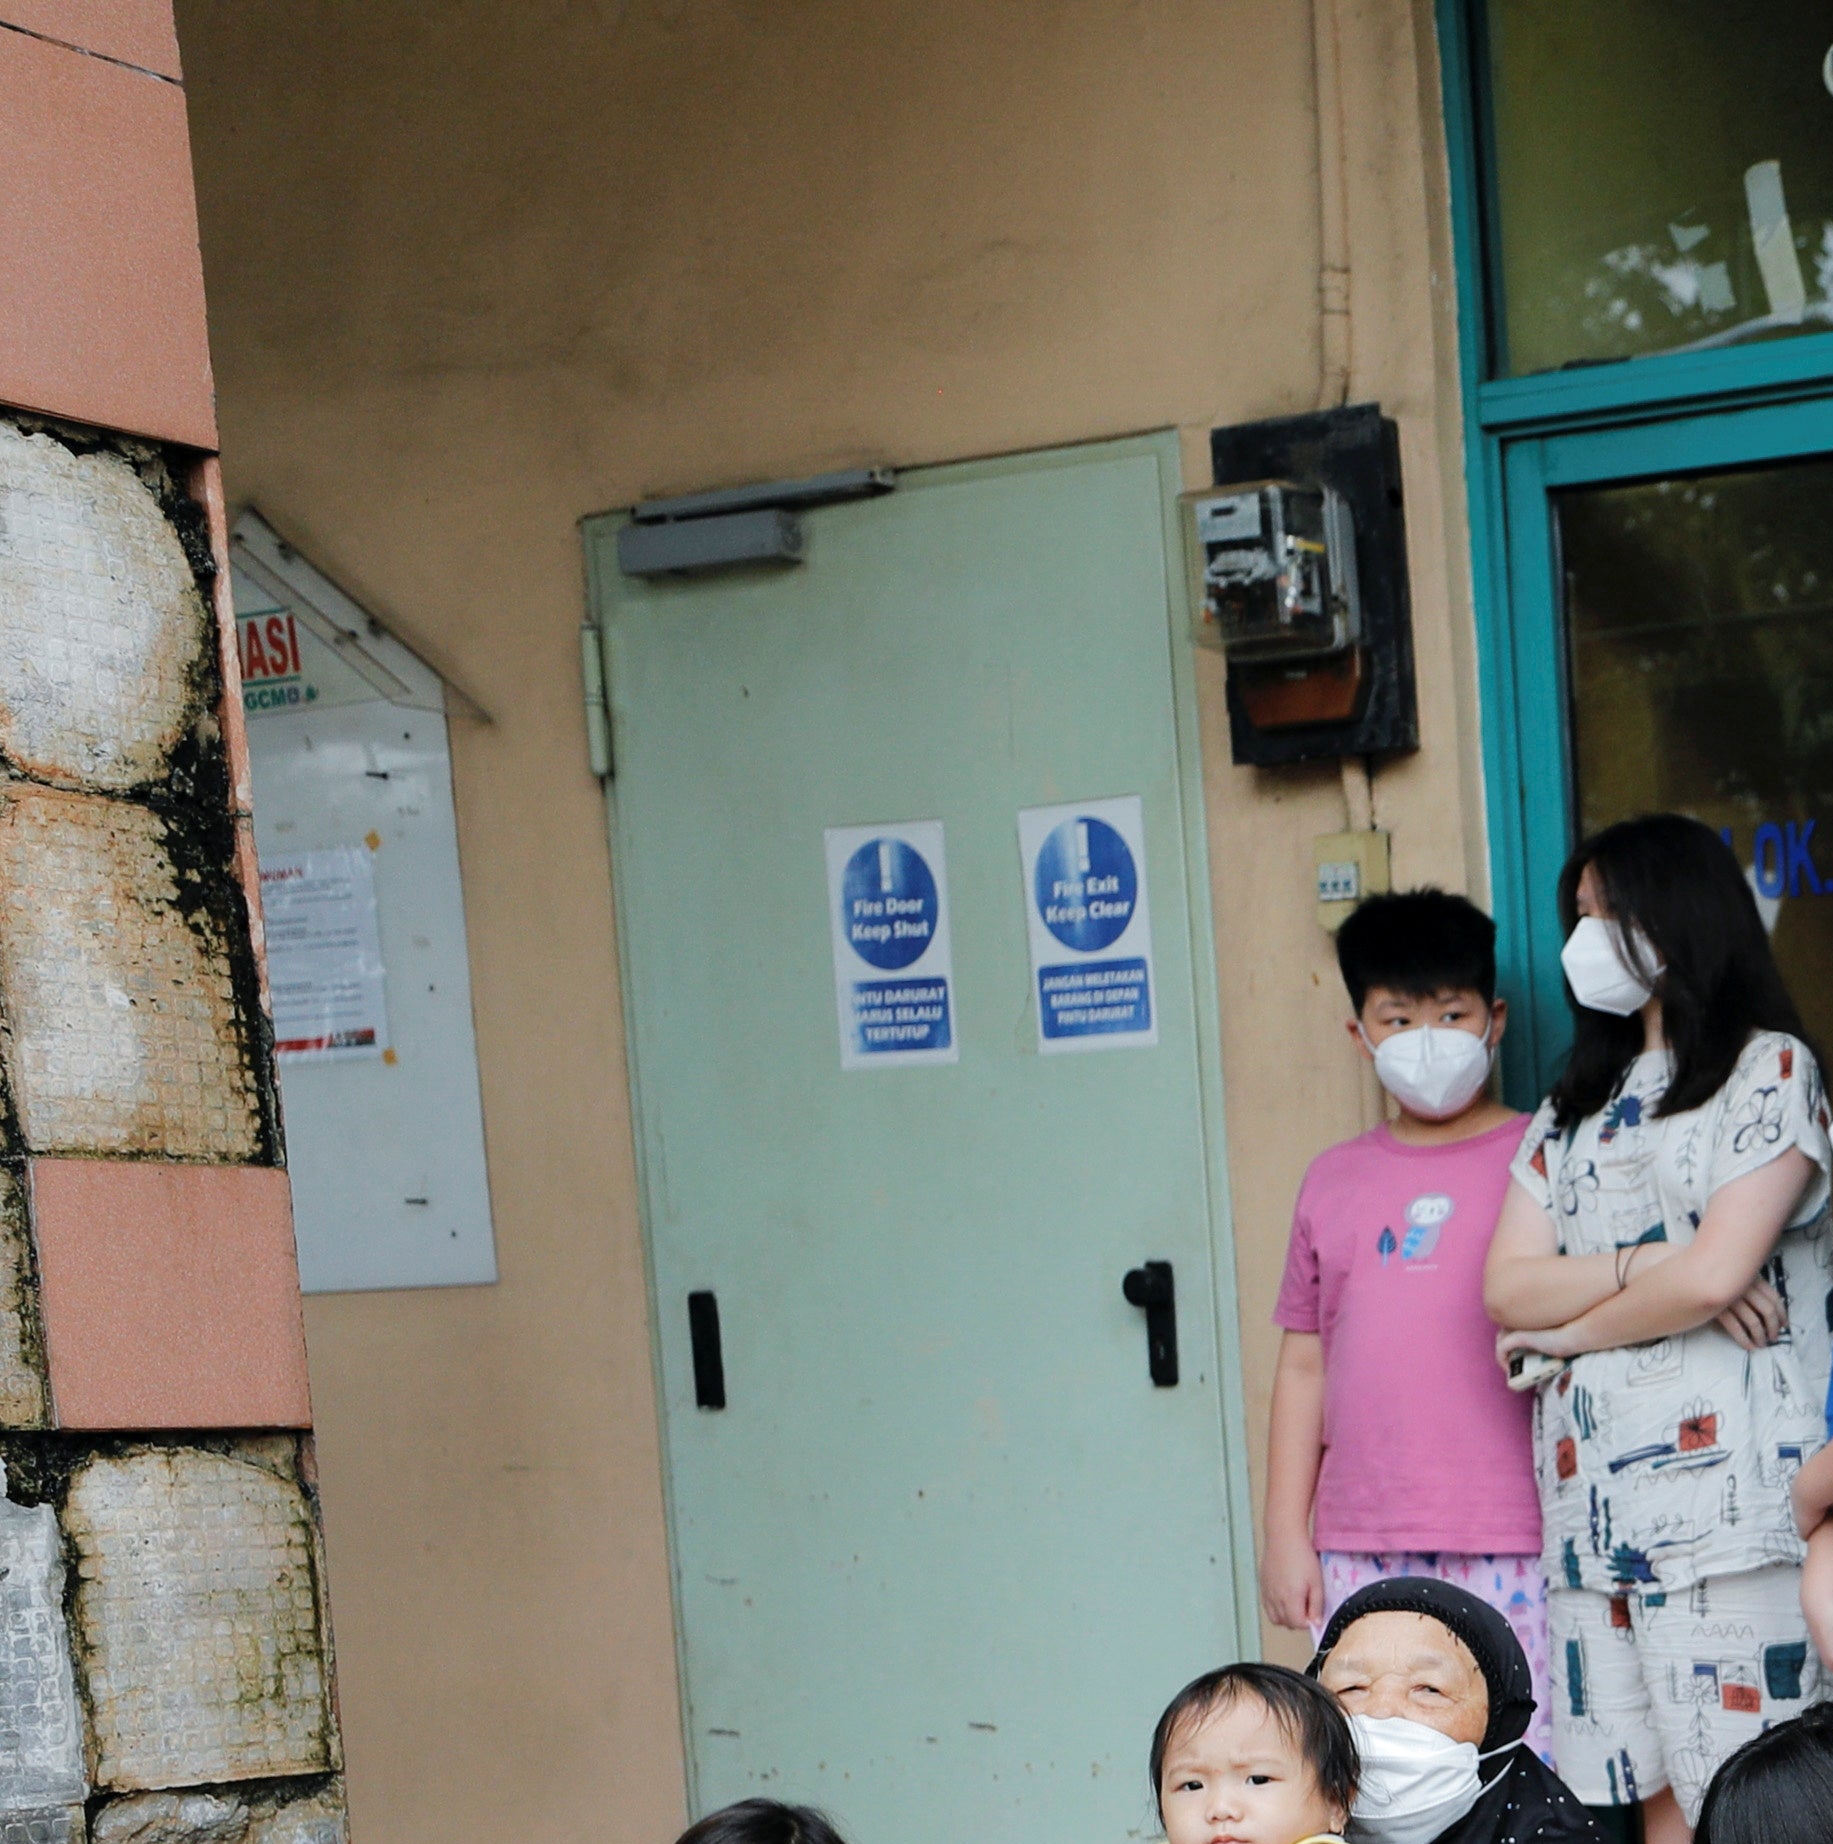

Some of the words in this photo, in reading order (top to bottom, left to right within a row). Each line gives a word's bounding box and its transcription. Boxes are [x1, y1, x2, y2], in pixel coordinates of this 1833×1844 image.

[1053, 879, 1084, 898] Fire
[1087, 875, 1119, 895] Exit
[853, 898, 884, 917] Fire
[886, 896, 924, 915] Door
[1046, 905, 1087, 923] Keep
[1089, 901, 1130, 920] Clear
[852, 922, 892, 945] Keep
[894, 919, 929, 938] Shut
